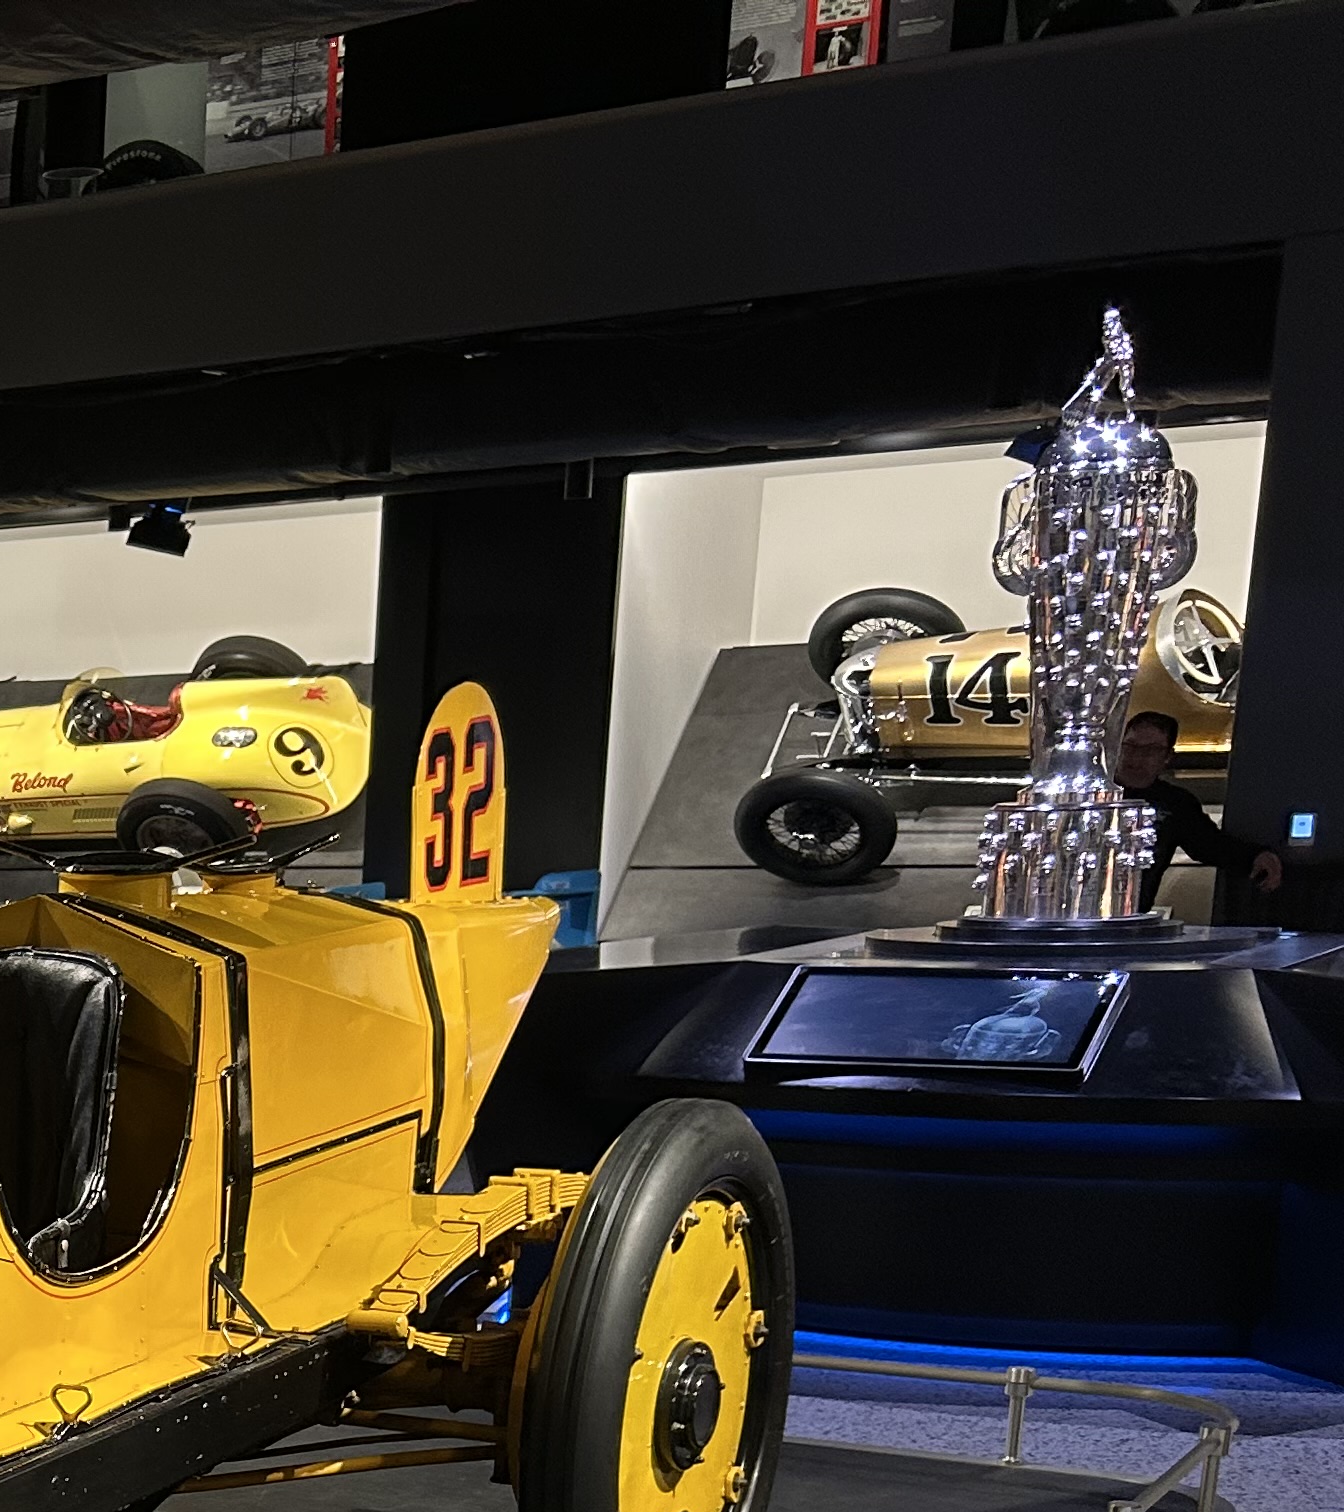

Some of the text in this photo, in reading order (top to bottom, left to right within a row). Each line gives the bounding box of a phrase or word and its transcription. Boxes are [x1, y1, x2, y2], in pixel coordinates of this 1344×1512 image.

[925, 651, 1029, 725] 14
[274, 727, 325, 776] 9
[11, 772, 74, 793] Belond
[424, 715, 496, 892] 32
